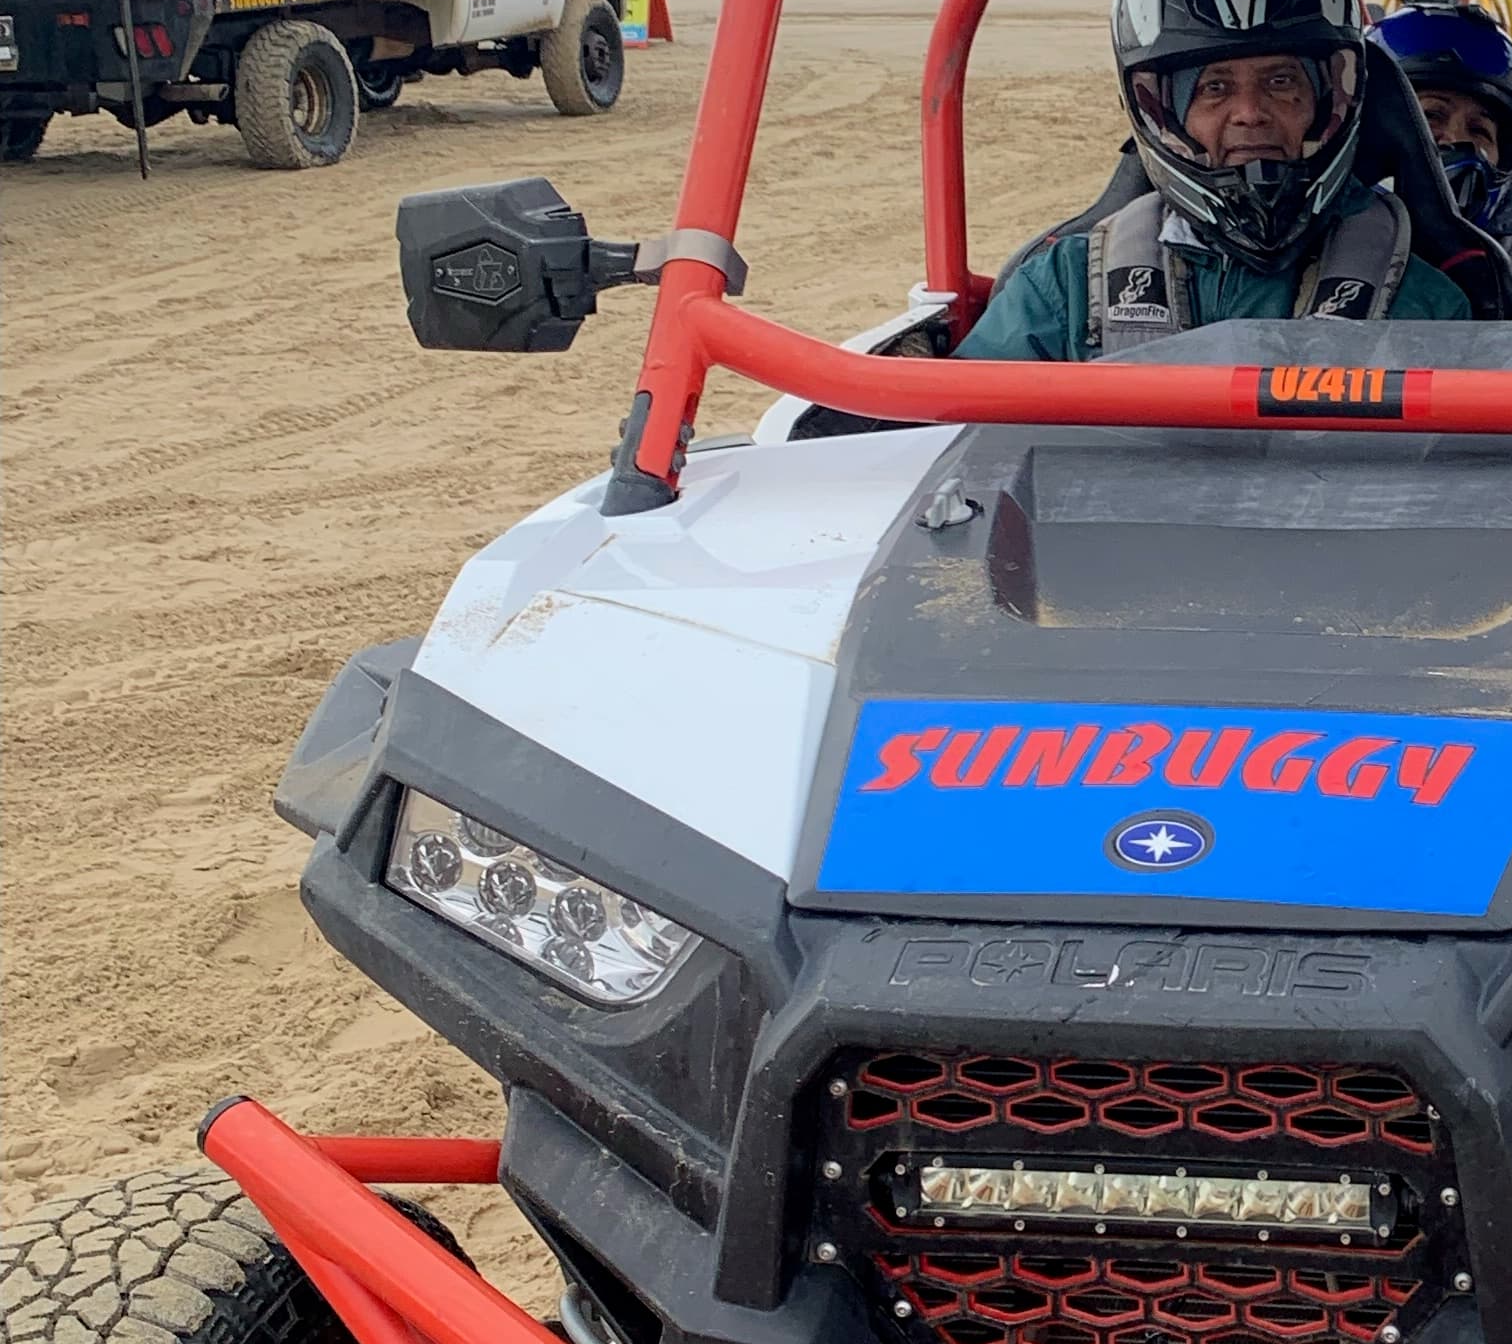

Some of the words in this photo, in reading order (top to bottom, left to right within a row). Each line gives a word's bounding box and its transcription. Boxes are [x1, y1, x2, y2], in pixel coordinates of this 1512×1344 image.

[1113, 305, 1166, 319] DragonFire
[859, 721, 1476, 806] SUNBUGGY
[888, 938, 1375, 998] POLARIS
